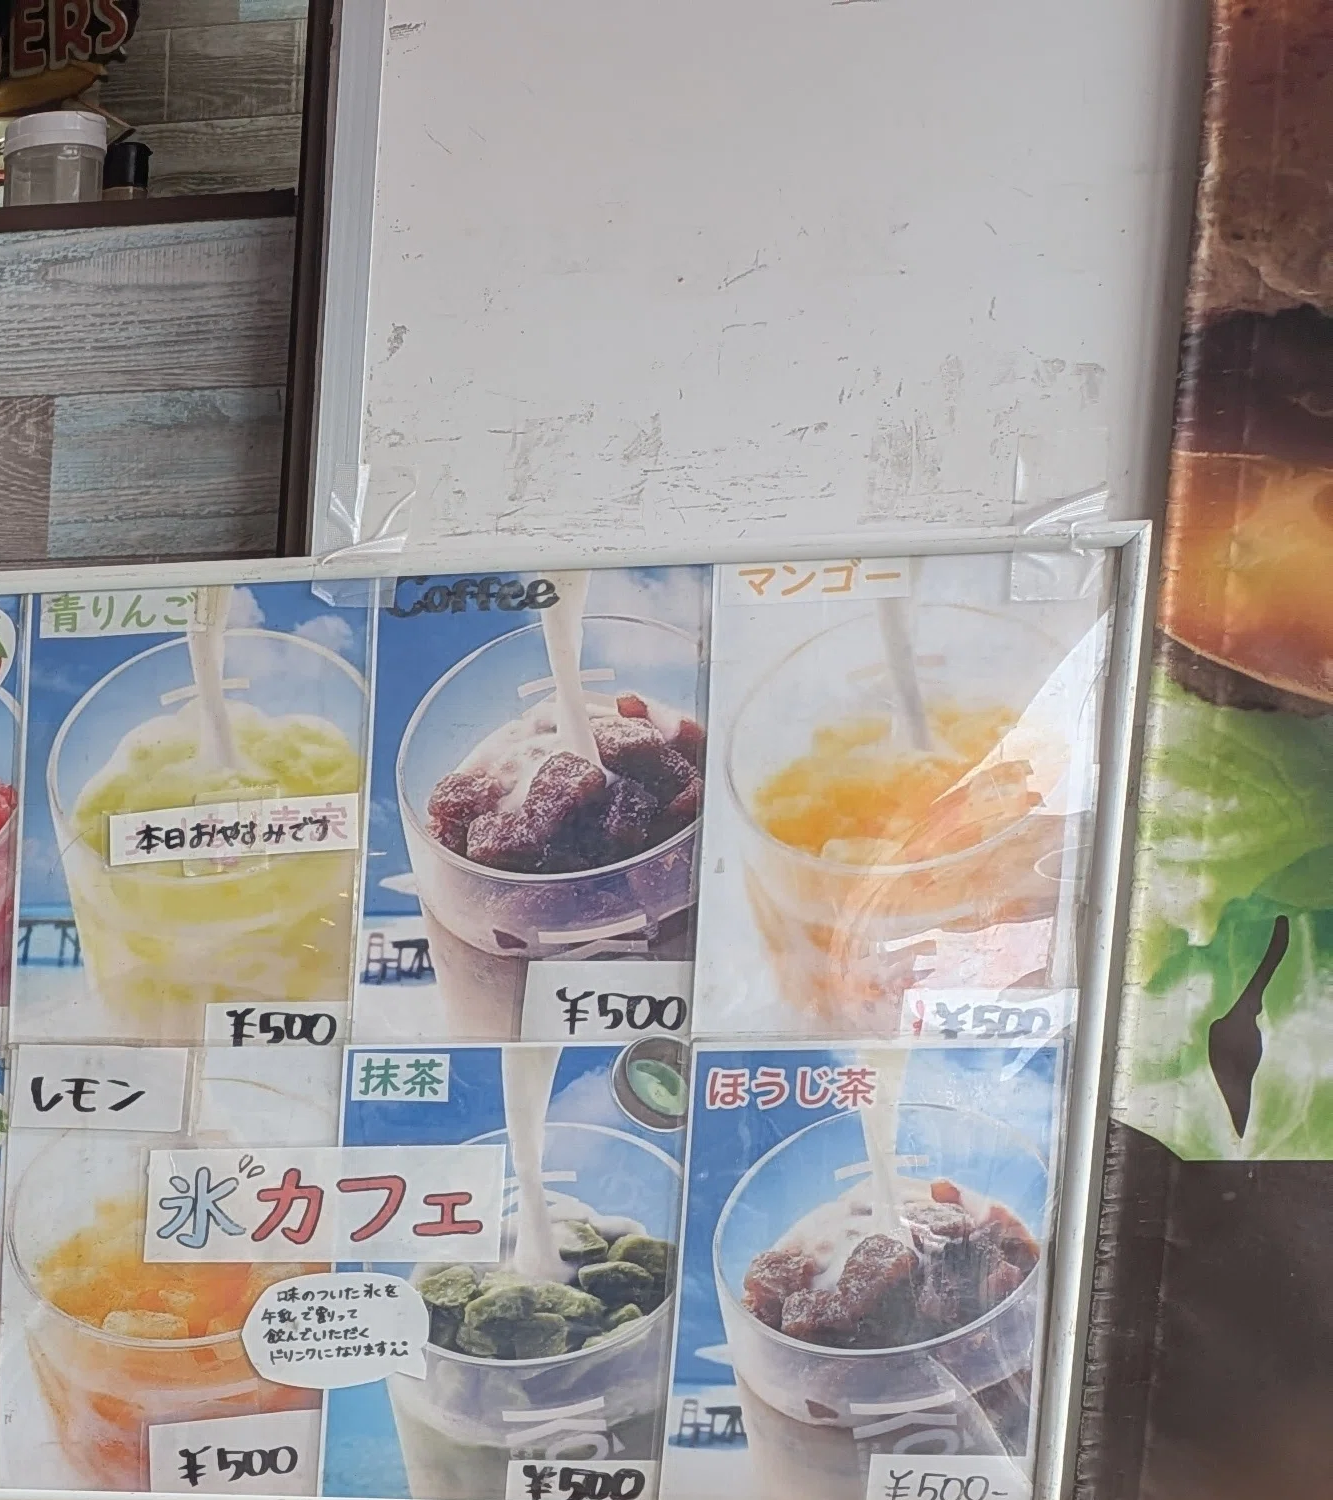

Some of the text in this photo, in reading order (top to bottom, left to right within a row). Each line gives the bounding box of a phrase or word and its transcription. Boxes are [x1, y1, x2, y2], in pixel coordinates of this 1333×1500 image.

[384, 573, 561, 619] Coffee
[736, 563, 903, 597] マンゴー
[48, 588, 199, 634] 青りんご
[227, 1006, 338, 1047] ¥500
[555, 985, 692, 1034] ¥500
[31, 1075, 147, 1113] レモン
[359, 1057, 444, 1099] 抹茶
[706, 1066, 878, 1112] ほうじ茶
[157, 1158, 483, 1250] 氷カフェ
[179, 1446, 299, 1486] ¥500
